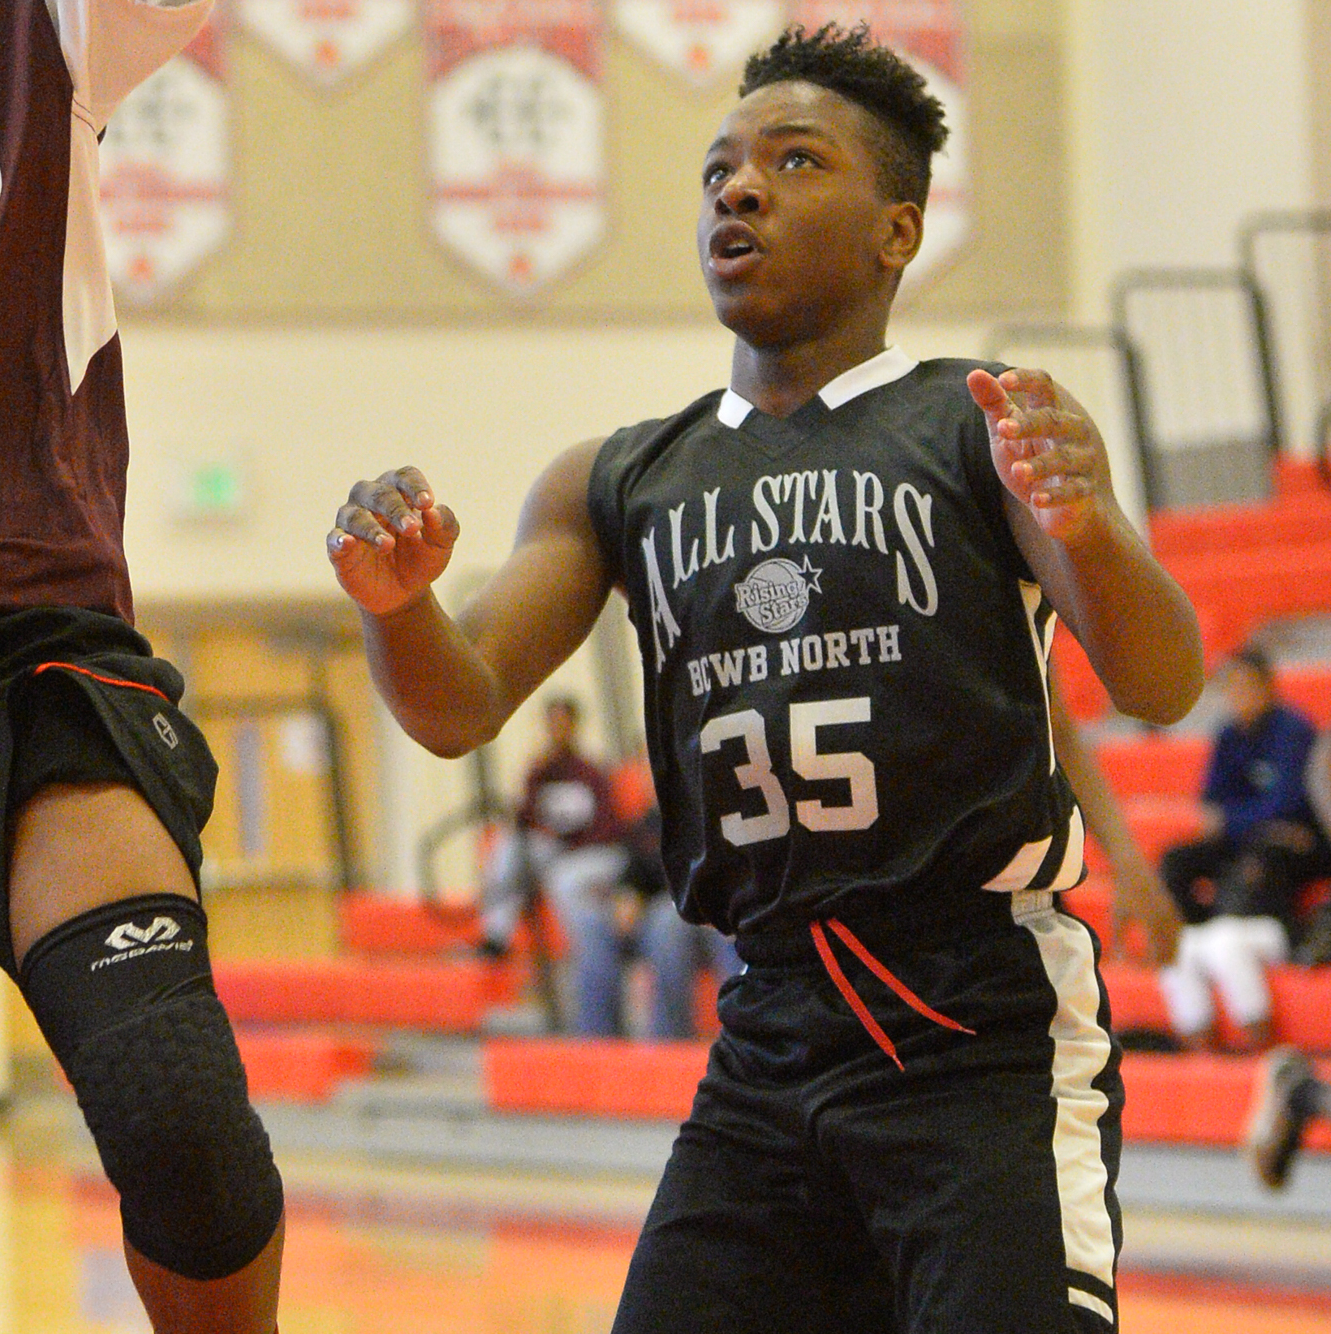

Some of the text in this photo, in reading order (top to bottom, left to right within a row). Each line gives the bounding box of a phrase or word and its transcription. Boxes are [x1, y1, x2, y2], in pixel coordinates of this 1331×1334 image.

[642, 469, 939, 673] ALL STARS
[736, 581, 799, 609] Rising
[759, 591, 808, 625] Stars
[687, 624, 902, 696] BCWB NORTH
[700, 697, 879, 847] 35
